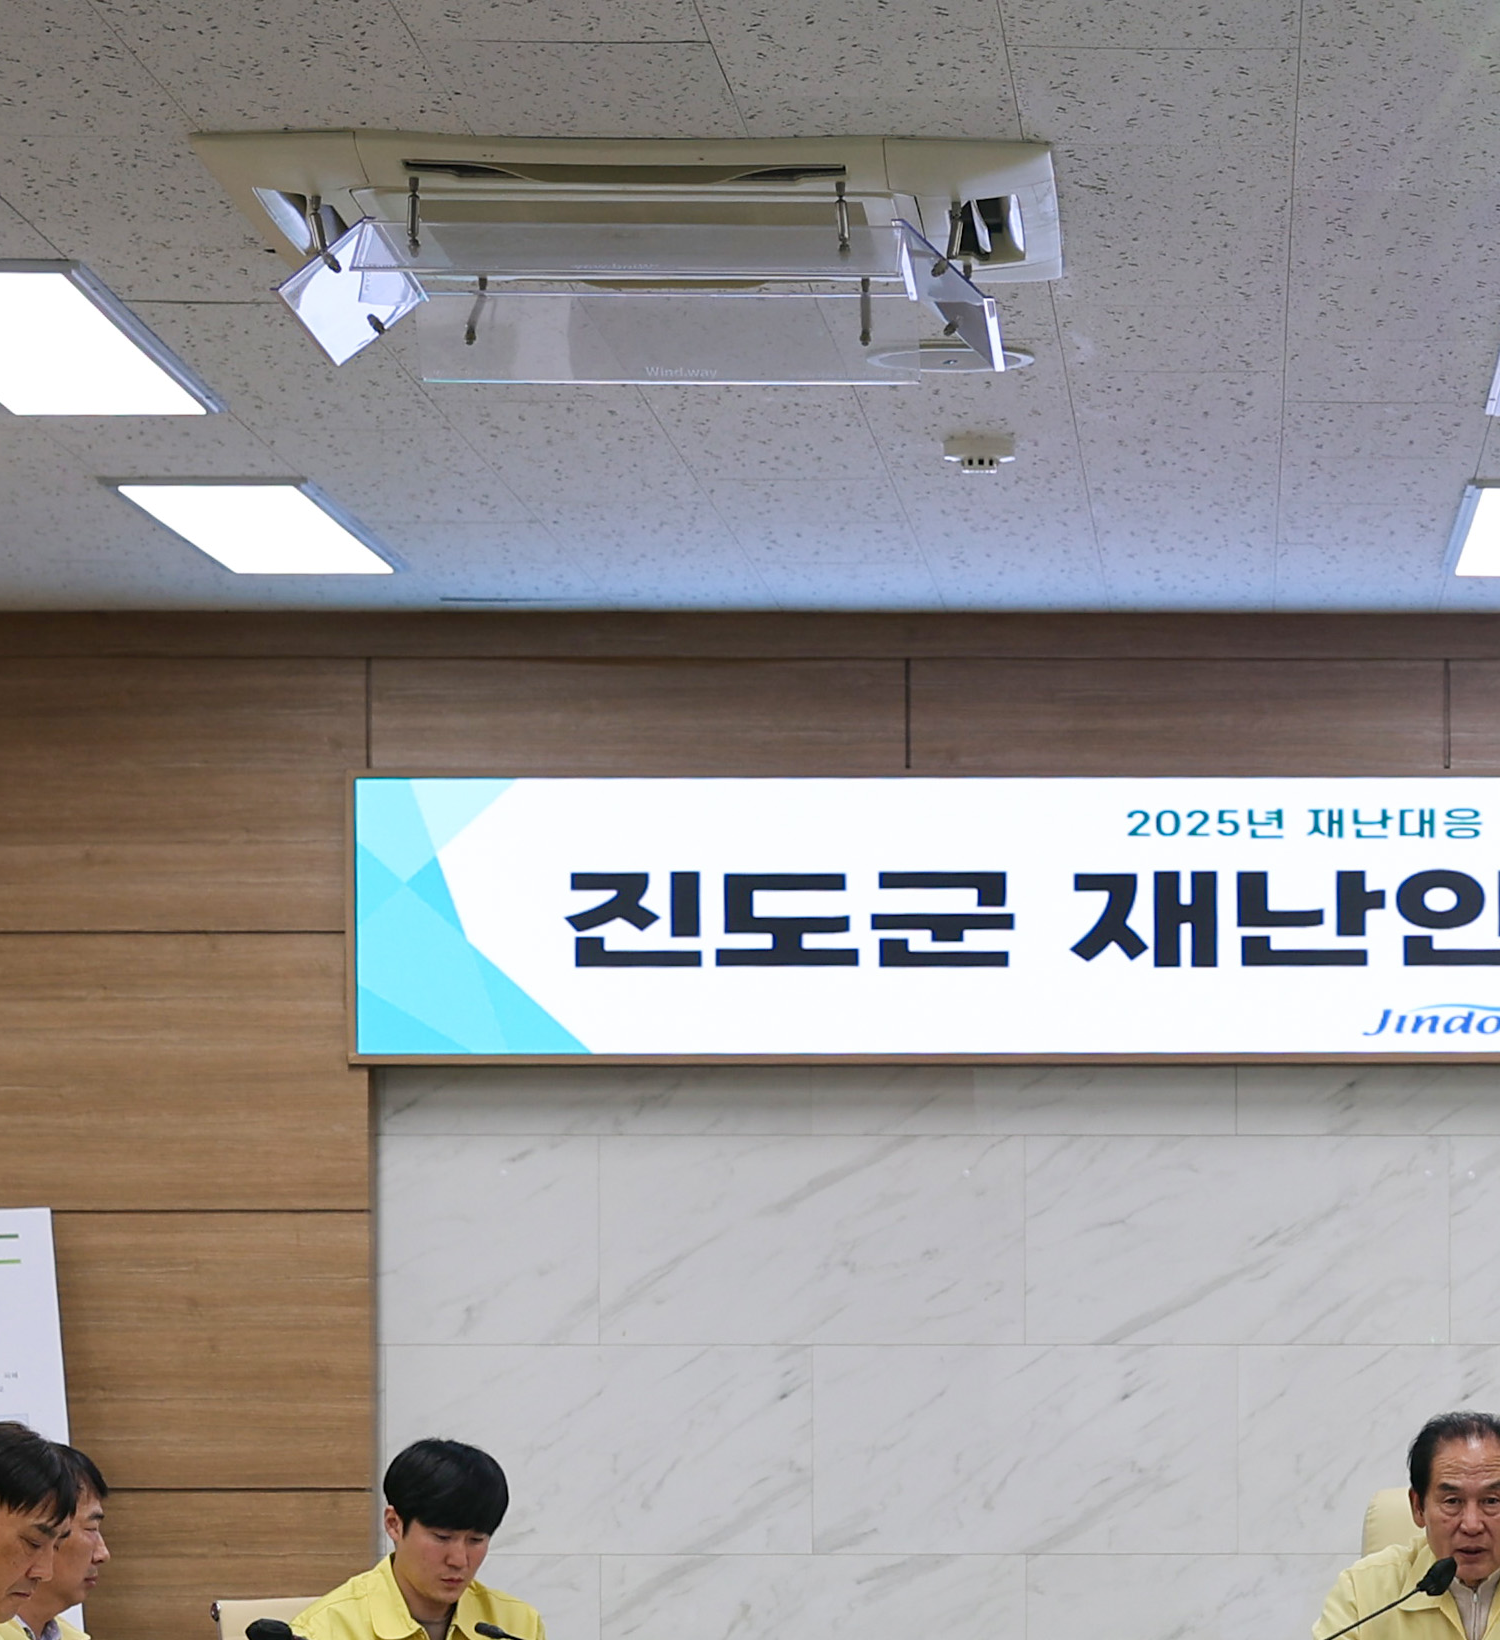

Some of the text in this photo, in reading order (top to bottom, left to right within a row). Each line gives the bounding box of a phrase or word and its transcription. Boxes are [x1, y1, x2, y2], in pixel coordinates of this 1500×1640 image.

[645, 366, 717, 378] Wind.way
[1126, 808, 1284, 839] 2025년
[1307, 808, 1482, 840] 재난대응
[564, 871, 1015, 968] 진도군
